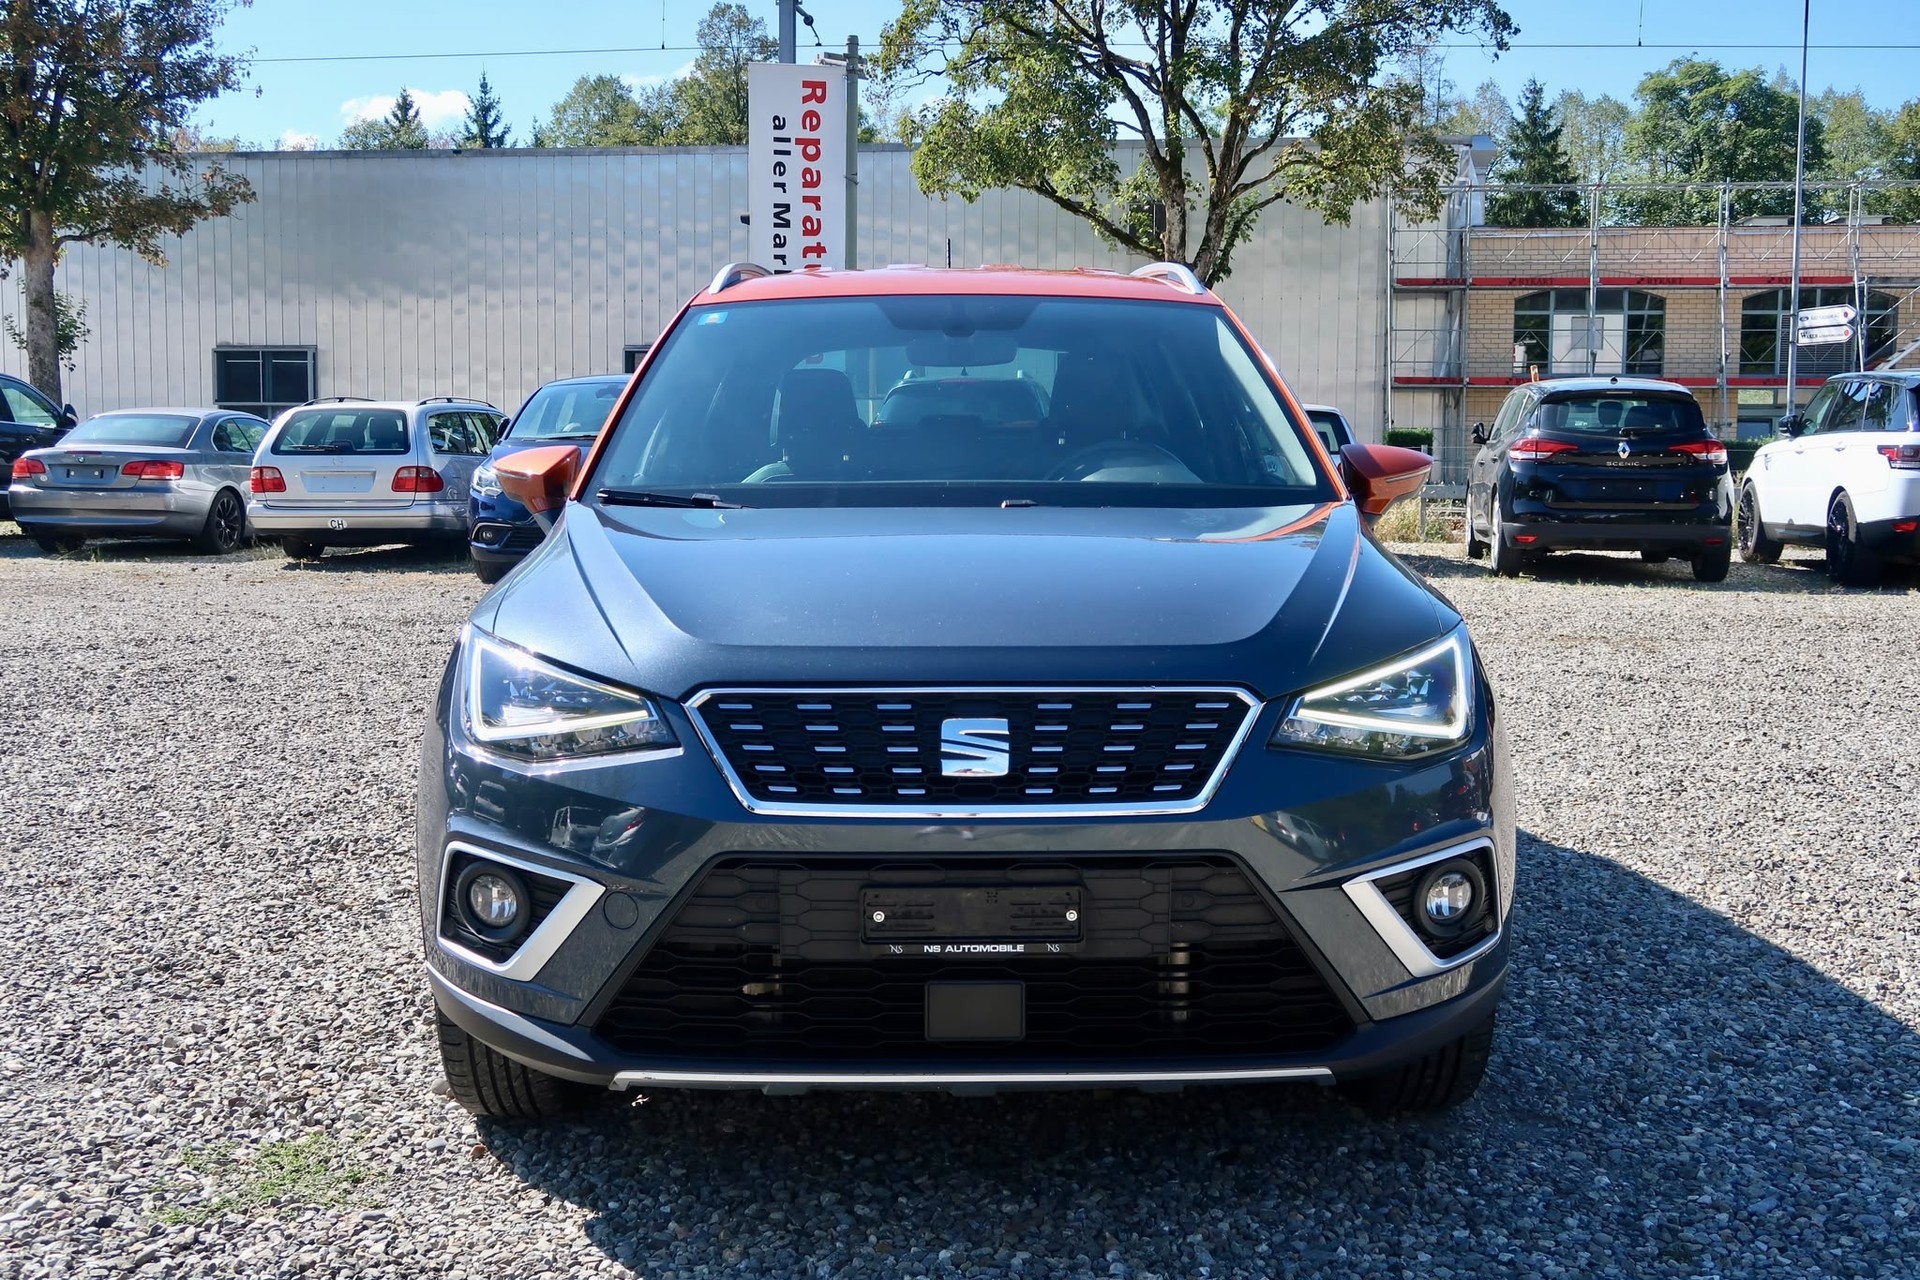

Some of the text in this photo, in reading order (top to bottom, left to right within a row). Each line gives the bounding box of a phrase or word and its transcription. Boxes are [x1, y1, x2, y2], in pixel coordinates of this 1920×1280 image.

[795, 79, 828, 269] Reparat
[772, 114, 793, 275] aller Mar
[330, 519, 344, 529] CH
[889, 944, 903, 954] NS
[924, 944, 1025, 953] NS AUTOMOBILE
[1046, 942, 1060, 952] NS
